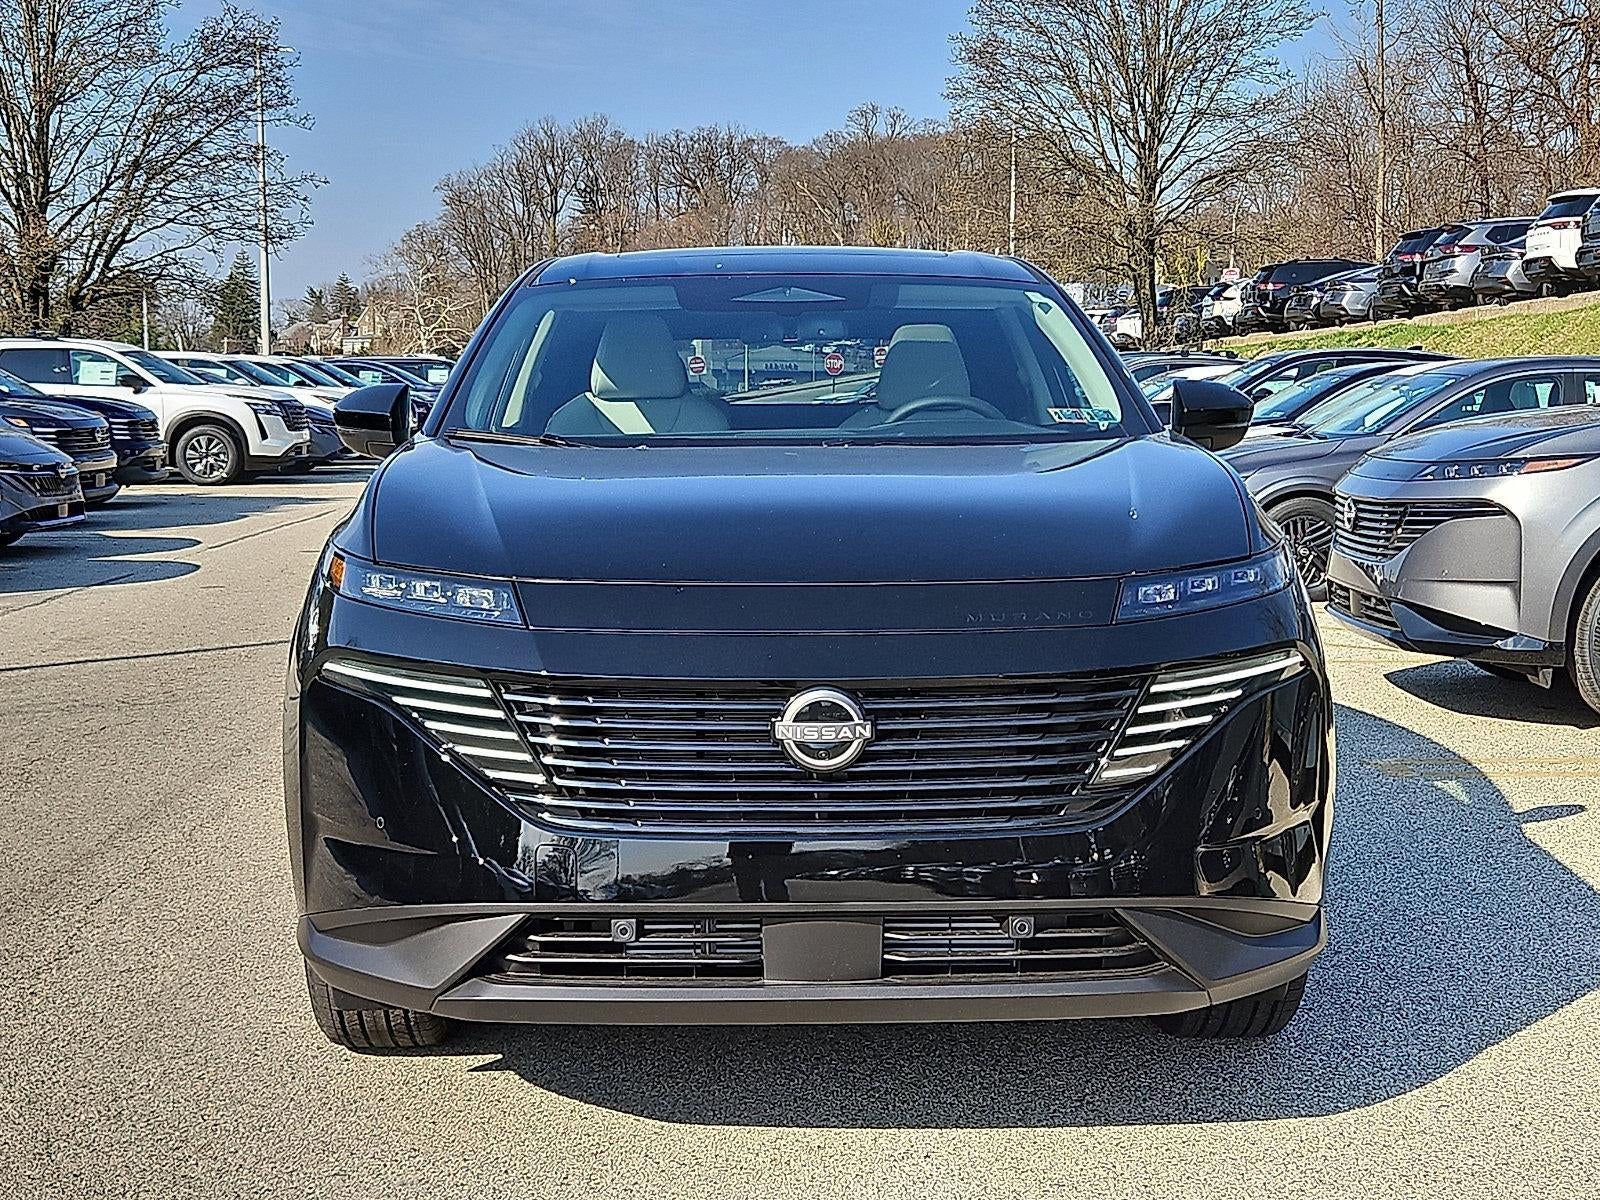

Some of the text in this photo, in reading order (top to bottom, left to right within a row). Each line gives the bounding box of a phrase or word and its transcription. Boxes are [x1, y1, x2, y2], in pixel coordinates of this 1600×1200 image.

[826, 359, 843, 369] STOP
[966, 610, 1093, 623] MURANO
[778, 725, 871, 740] NISSAN
